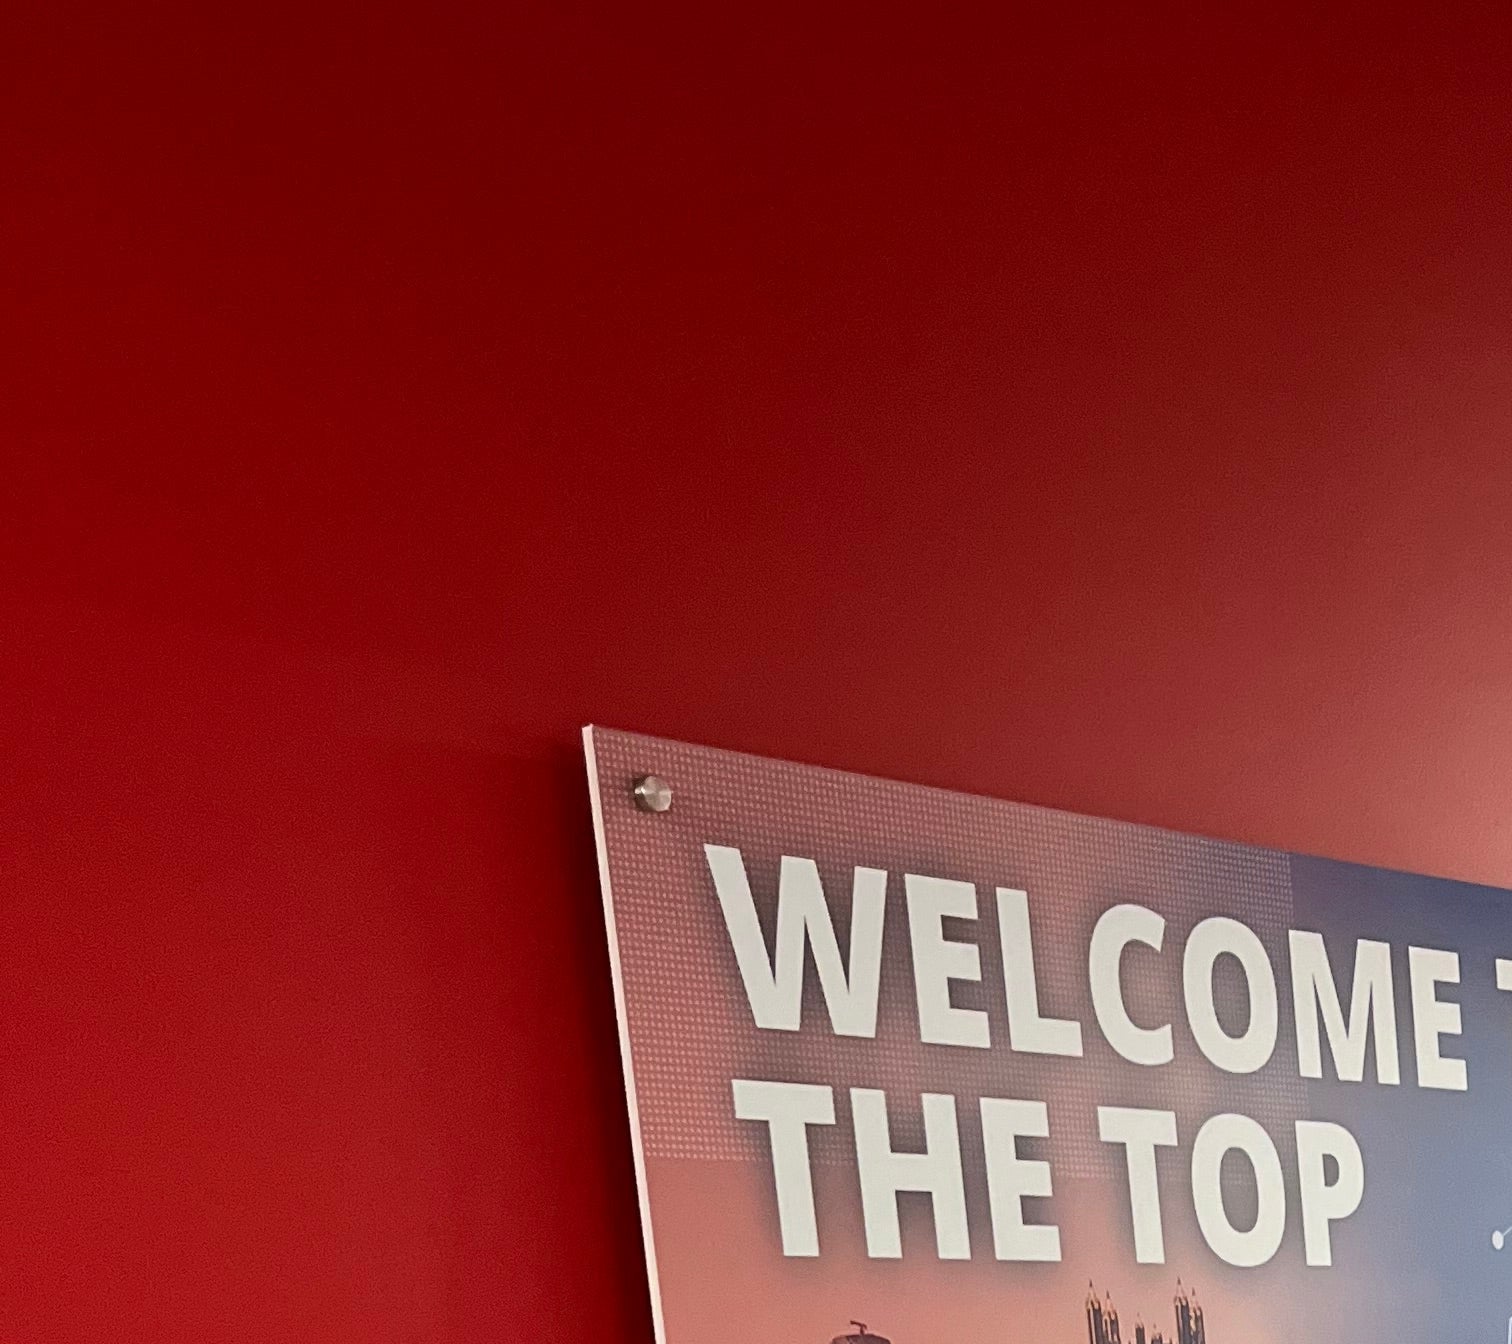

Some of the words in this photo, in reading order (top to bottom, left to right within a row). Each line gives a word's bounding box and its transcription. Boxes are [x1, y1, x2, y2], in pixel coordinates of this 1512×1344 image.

[703, 842, 1468, 1091] WELCOME
[731, 1079, 1062, 1263] THE
[1098, 1105, 1366, 1267] TOP
